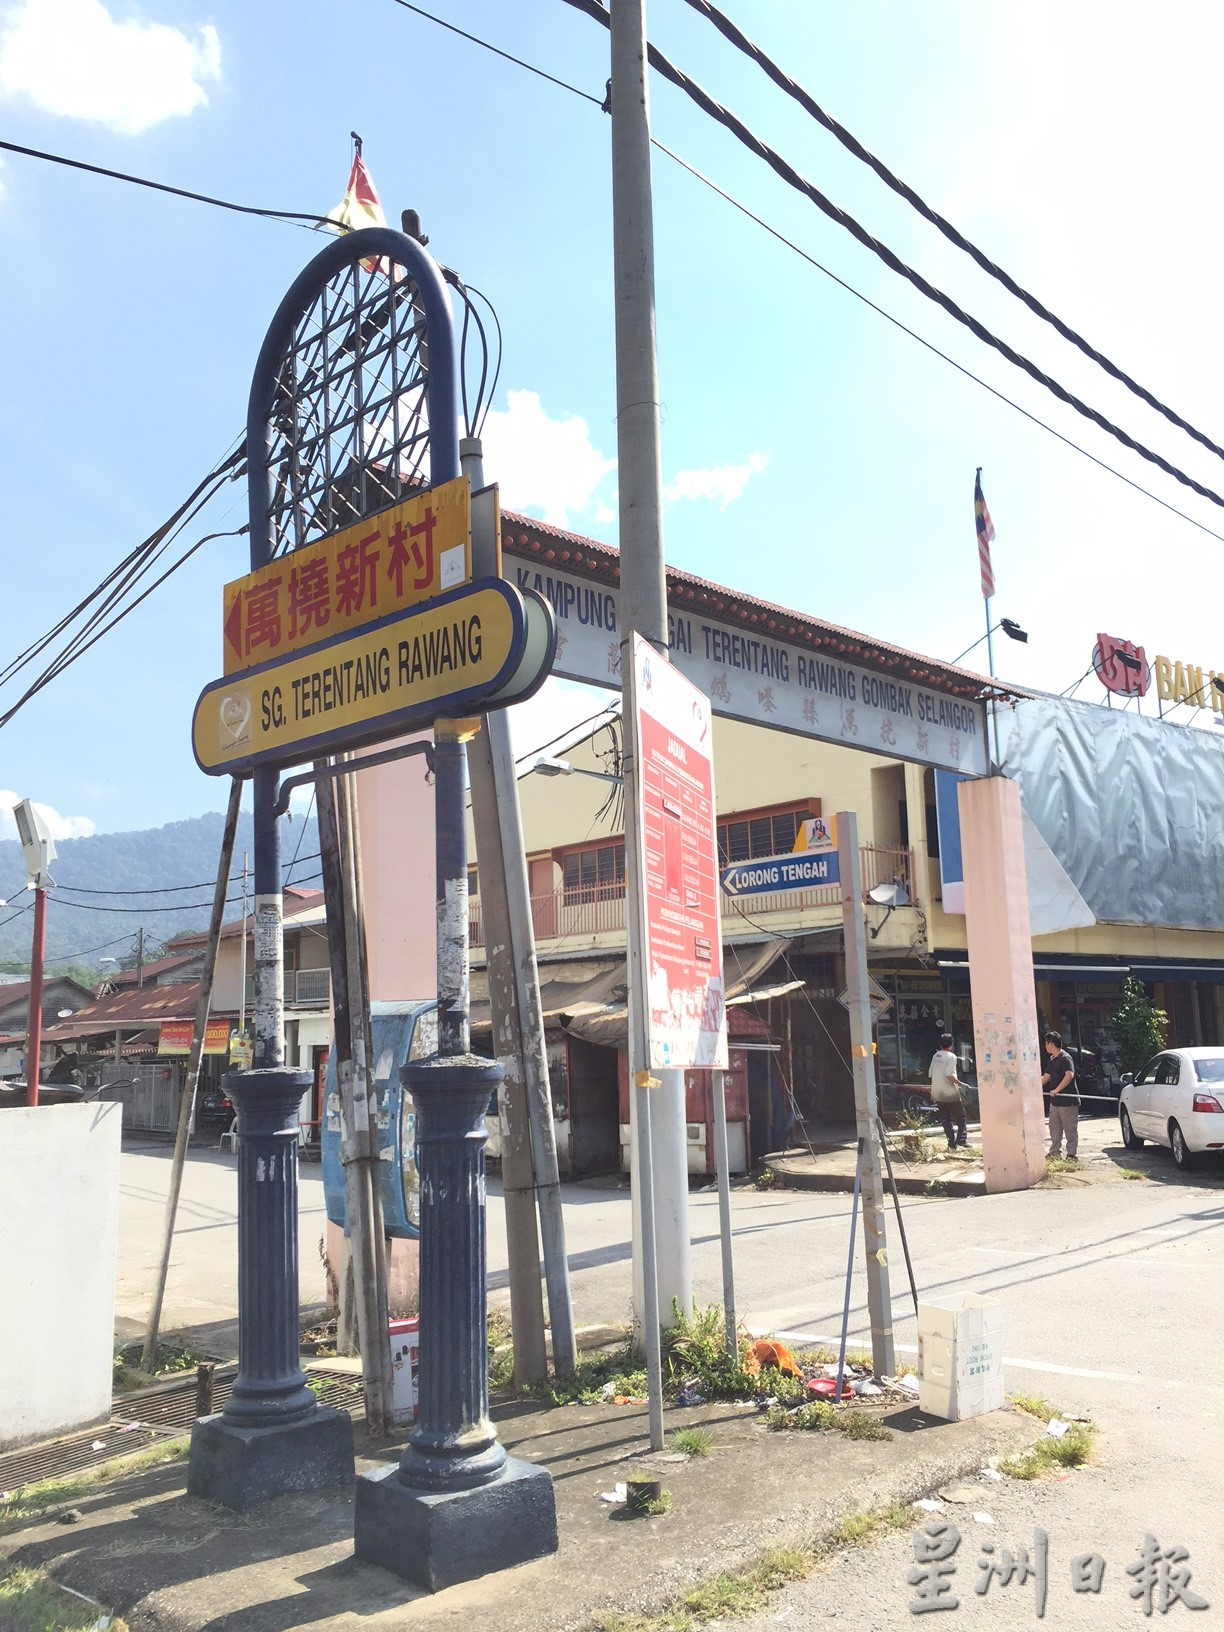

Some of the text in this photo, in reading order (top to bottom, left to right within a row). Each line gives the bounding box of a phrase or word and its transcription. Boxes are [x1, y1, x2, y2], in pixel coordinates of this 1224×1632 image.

[244, 506, 437, 650] 萬撓新村
[261, 614, 482, 732] SG. TERENTANG RAWANG
[702, 625, 790, 683] TERENTANG
[799, 655, 856, 702] RAWANG
[862, 674, 913, 718] GOMBAK
[918, 692, 976, 735] SELANGOR
[1155, 655, 1206, 710] BAN
[667, 736, 688, 765] JADUAL
[735, 861, 828, 889] LORONG TENGAH
